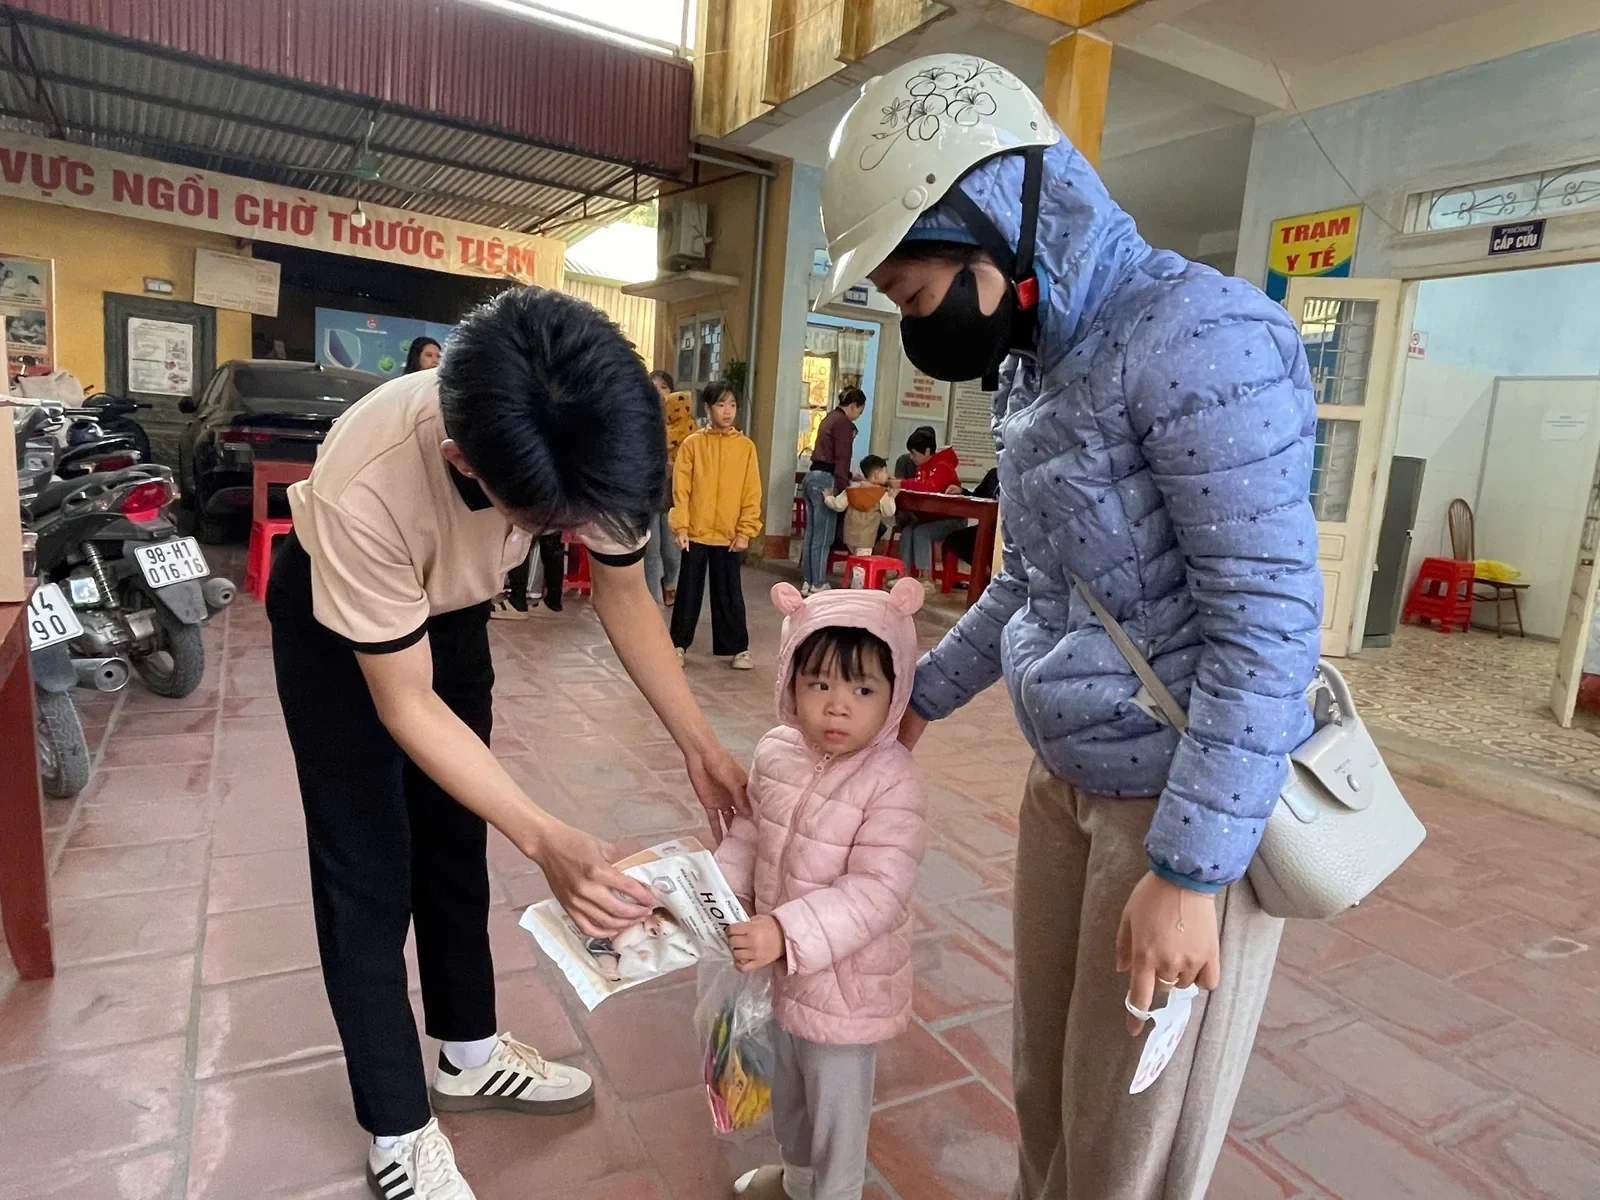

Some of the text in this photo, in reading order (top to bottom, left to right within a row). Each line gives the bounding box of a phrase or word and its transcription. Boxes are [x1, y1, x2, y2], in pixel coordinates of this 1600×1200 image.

[0, 147, 535, 277] VỰC NGỒI CHỜ TRƯỚC TIÊM
[1281, 216, 1351, 244] TRẠM
[1286, 242, 1336, 272] Y TẾ
[146, 541, 192, 565] 98-H1
[149, 558, 204, 584] 016.16
